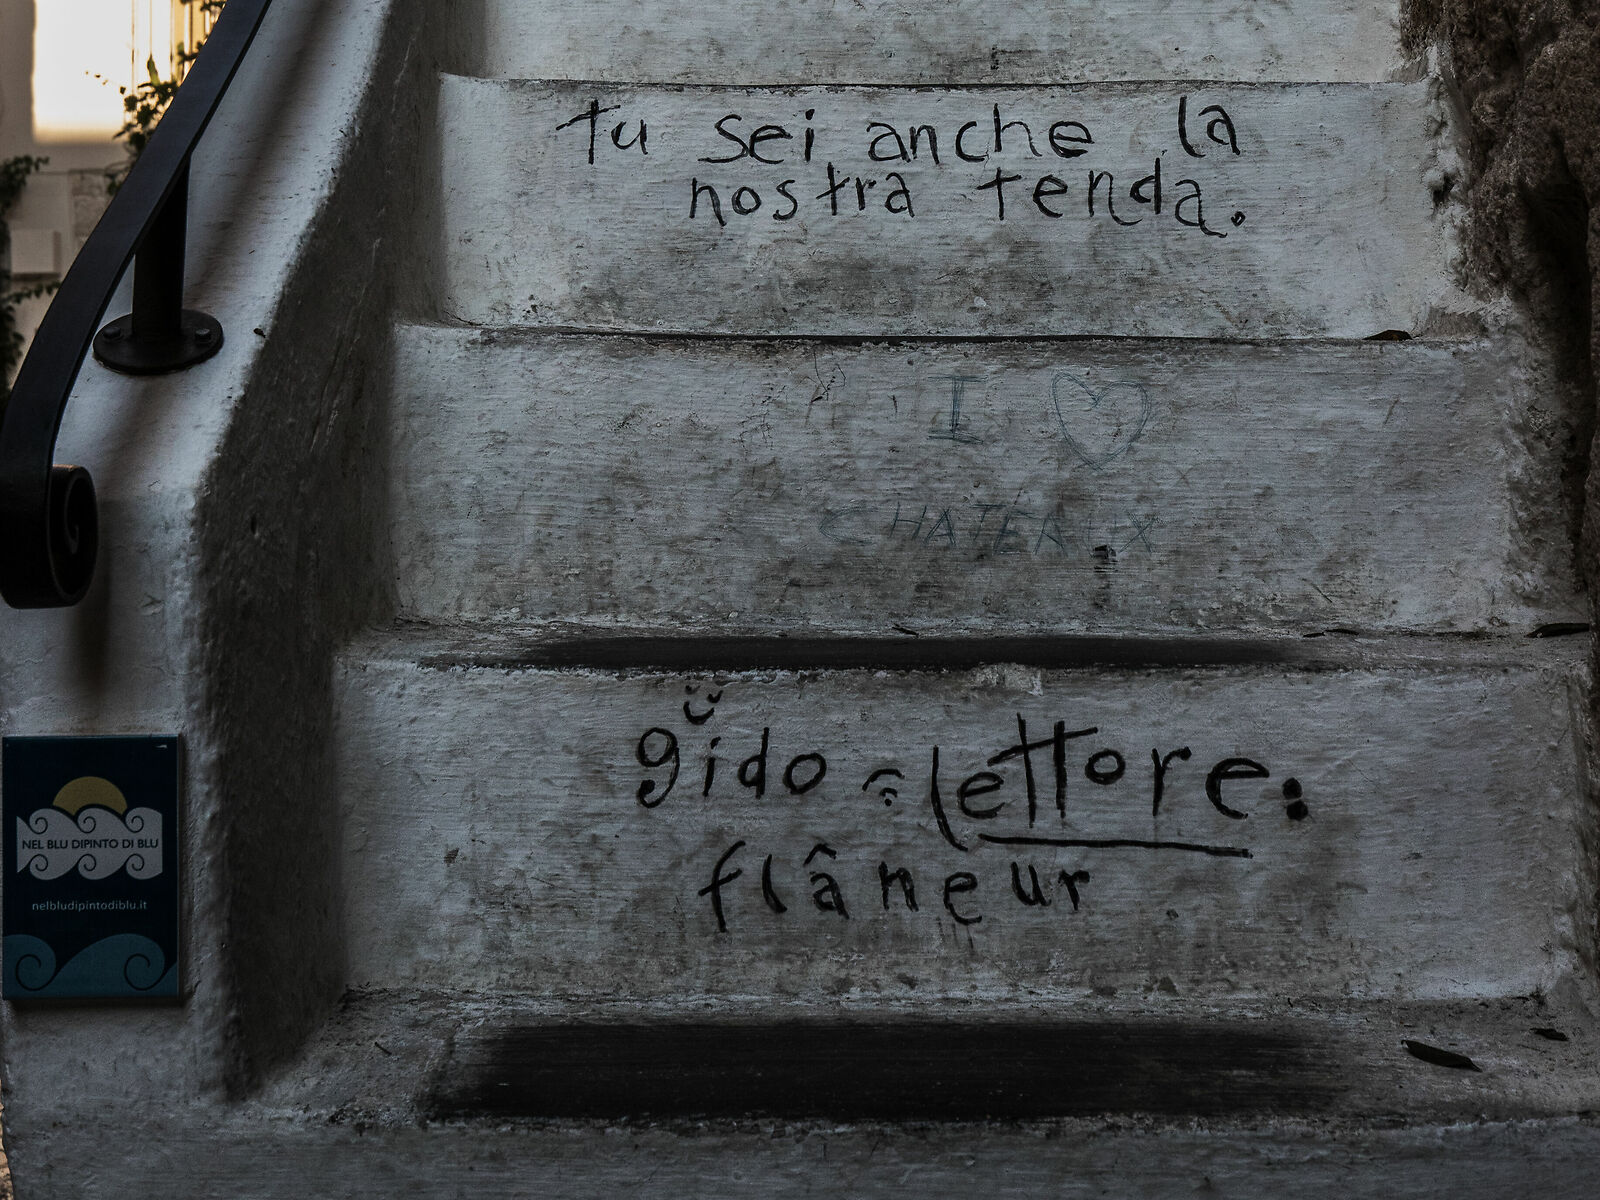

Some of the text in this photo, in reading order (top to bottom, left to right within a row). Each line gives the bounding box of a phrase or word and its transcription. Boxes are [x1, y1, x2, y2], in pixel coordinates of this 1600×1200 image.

[699, 108, 815, 165] sei
[865, 103, 1094, 165] anche
[1178, 96, 1241, 158] la
[688, 161, 915, 227] nostra
[22, 839, 159, 850] NEL BLU DIPINTO DI BLU
[32, 900, 148, 912] nelbludipintodiblu.it
